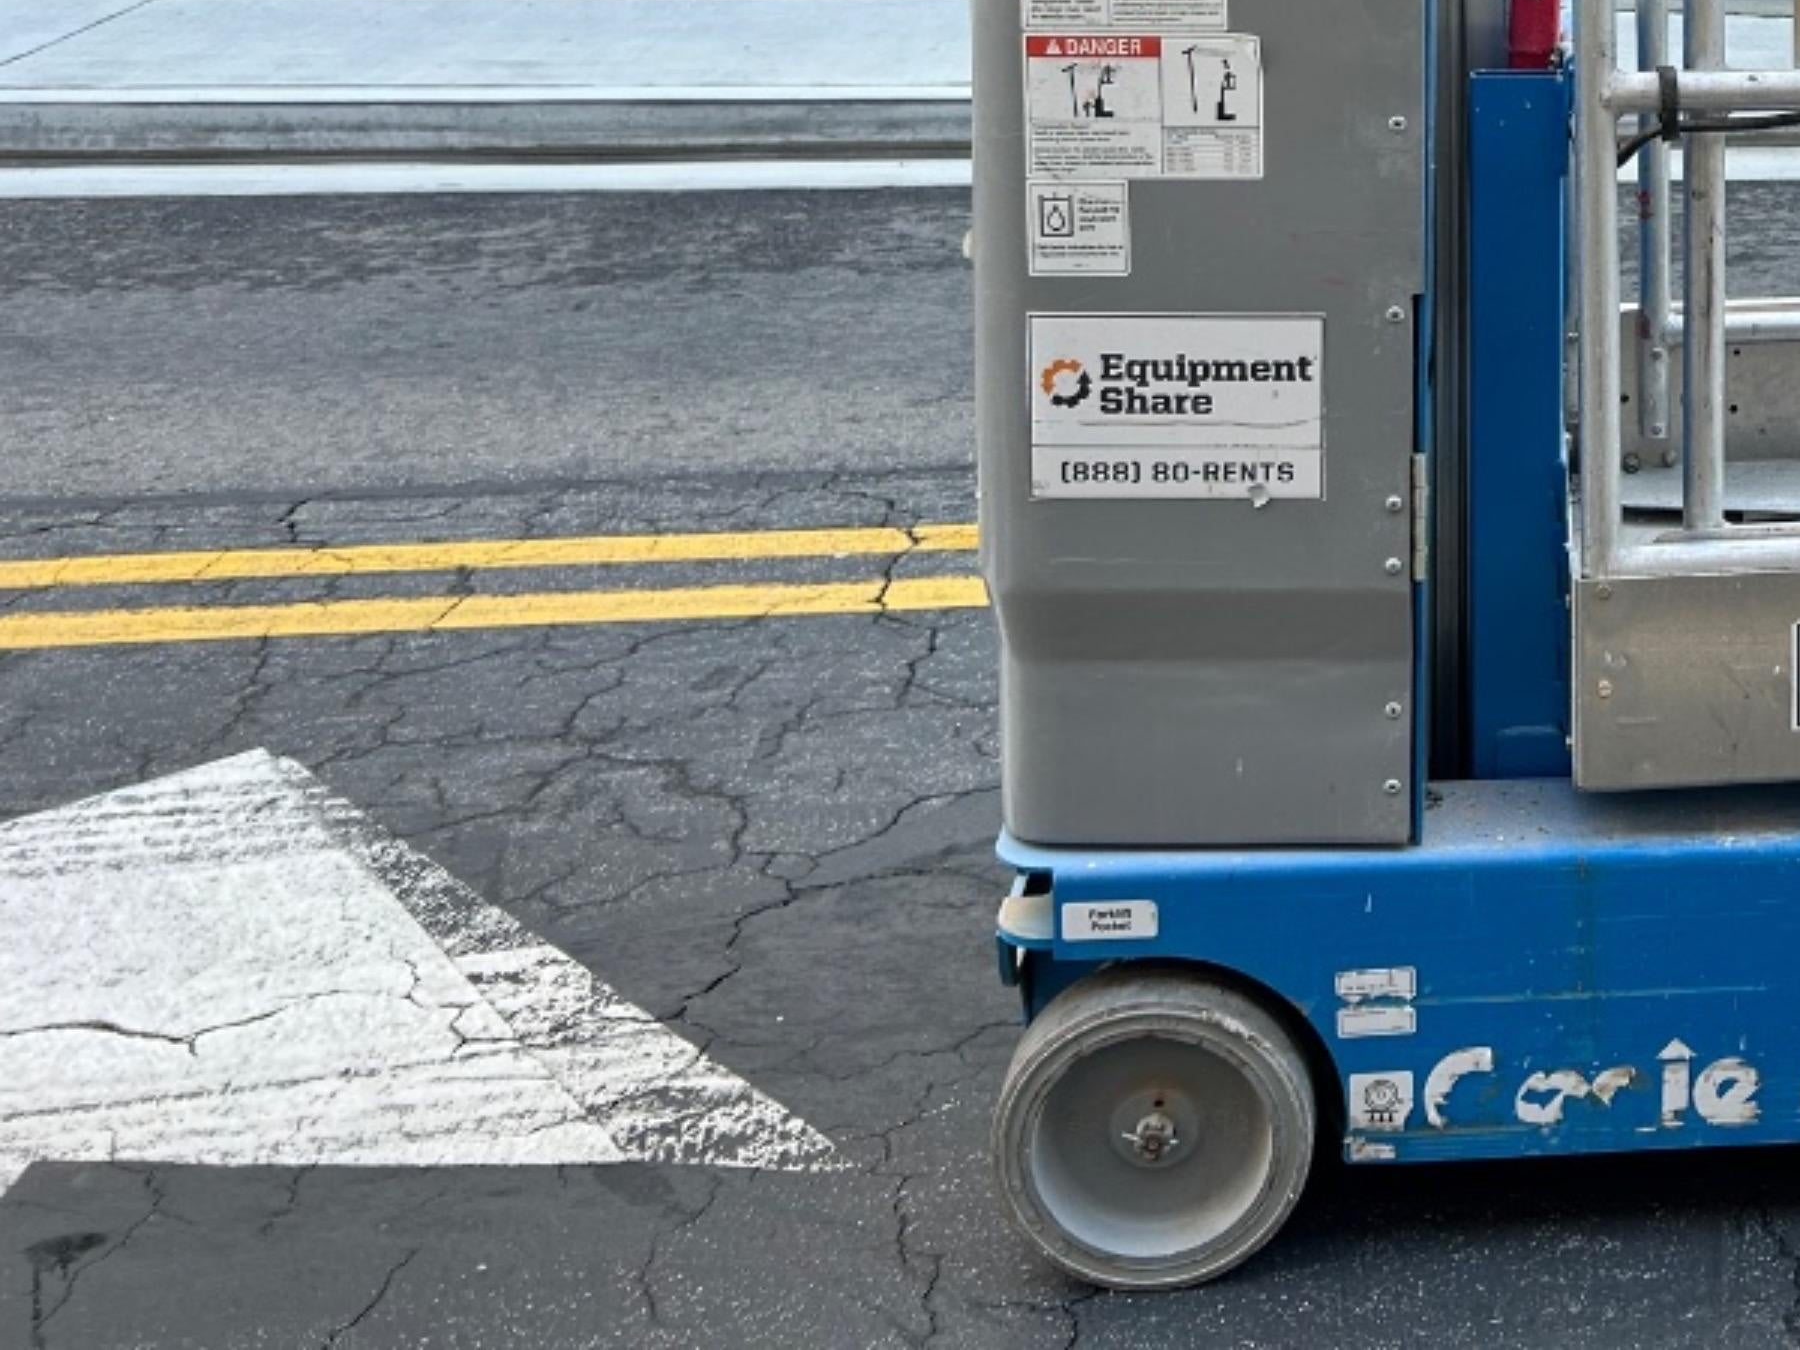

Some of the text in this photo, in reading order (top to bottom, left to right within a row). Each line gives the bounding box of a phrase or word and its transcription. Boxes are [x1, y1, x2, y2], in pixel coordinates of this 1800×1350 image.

[1065, 37, 1143, 56] DANGER
[1099, 353, 1314, 388] Equipment
[1099, 387, 1214, 415] Share
[1151, 460, 1295, 484] 80-RENTS
